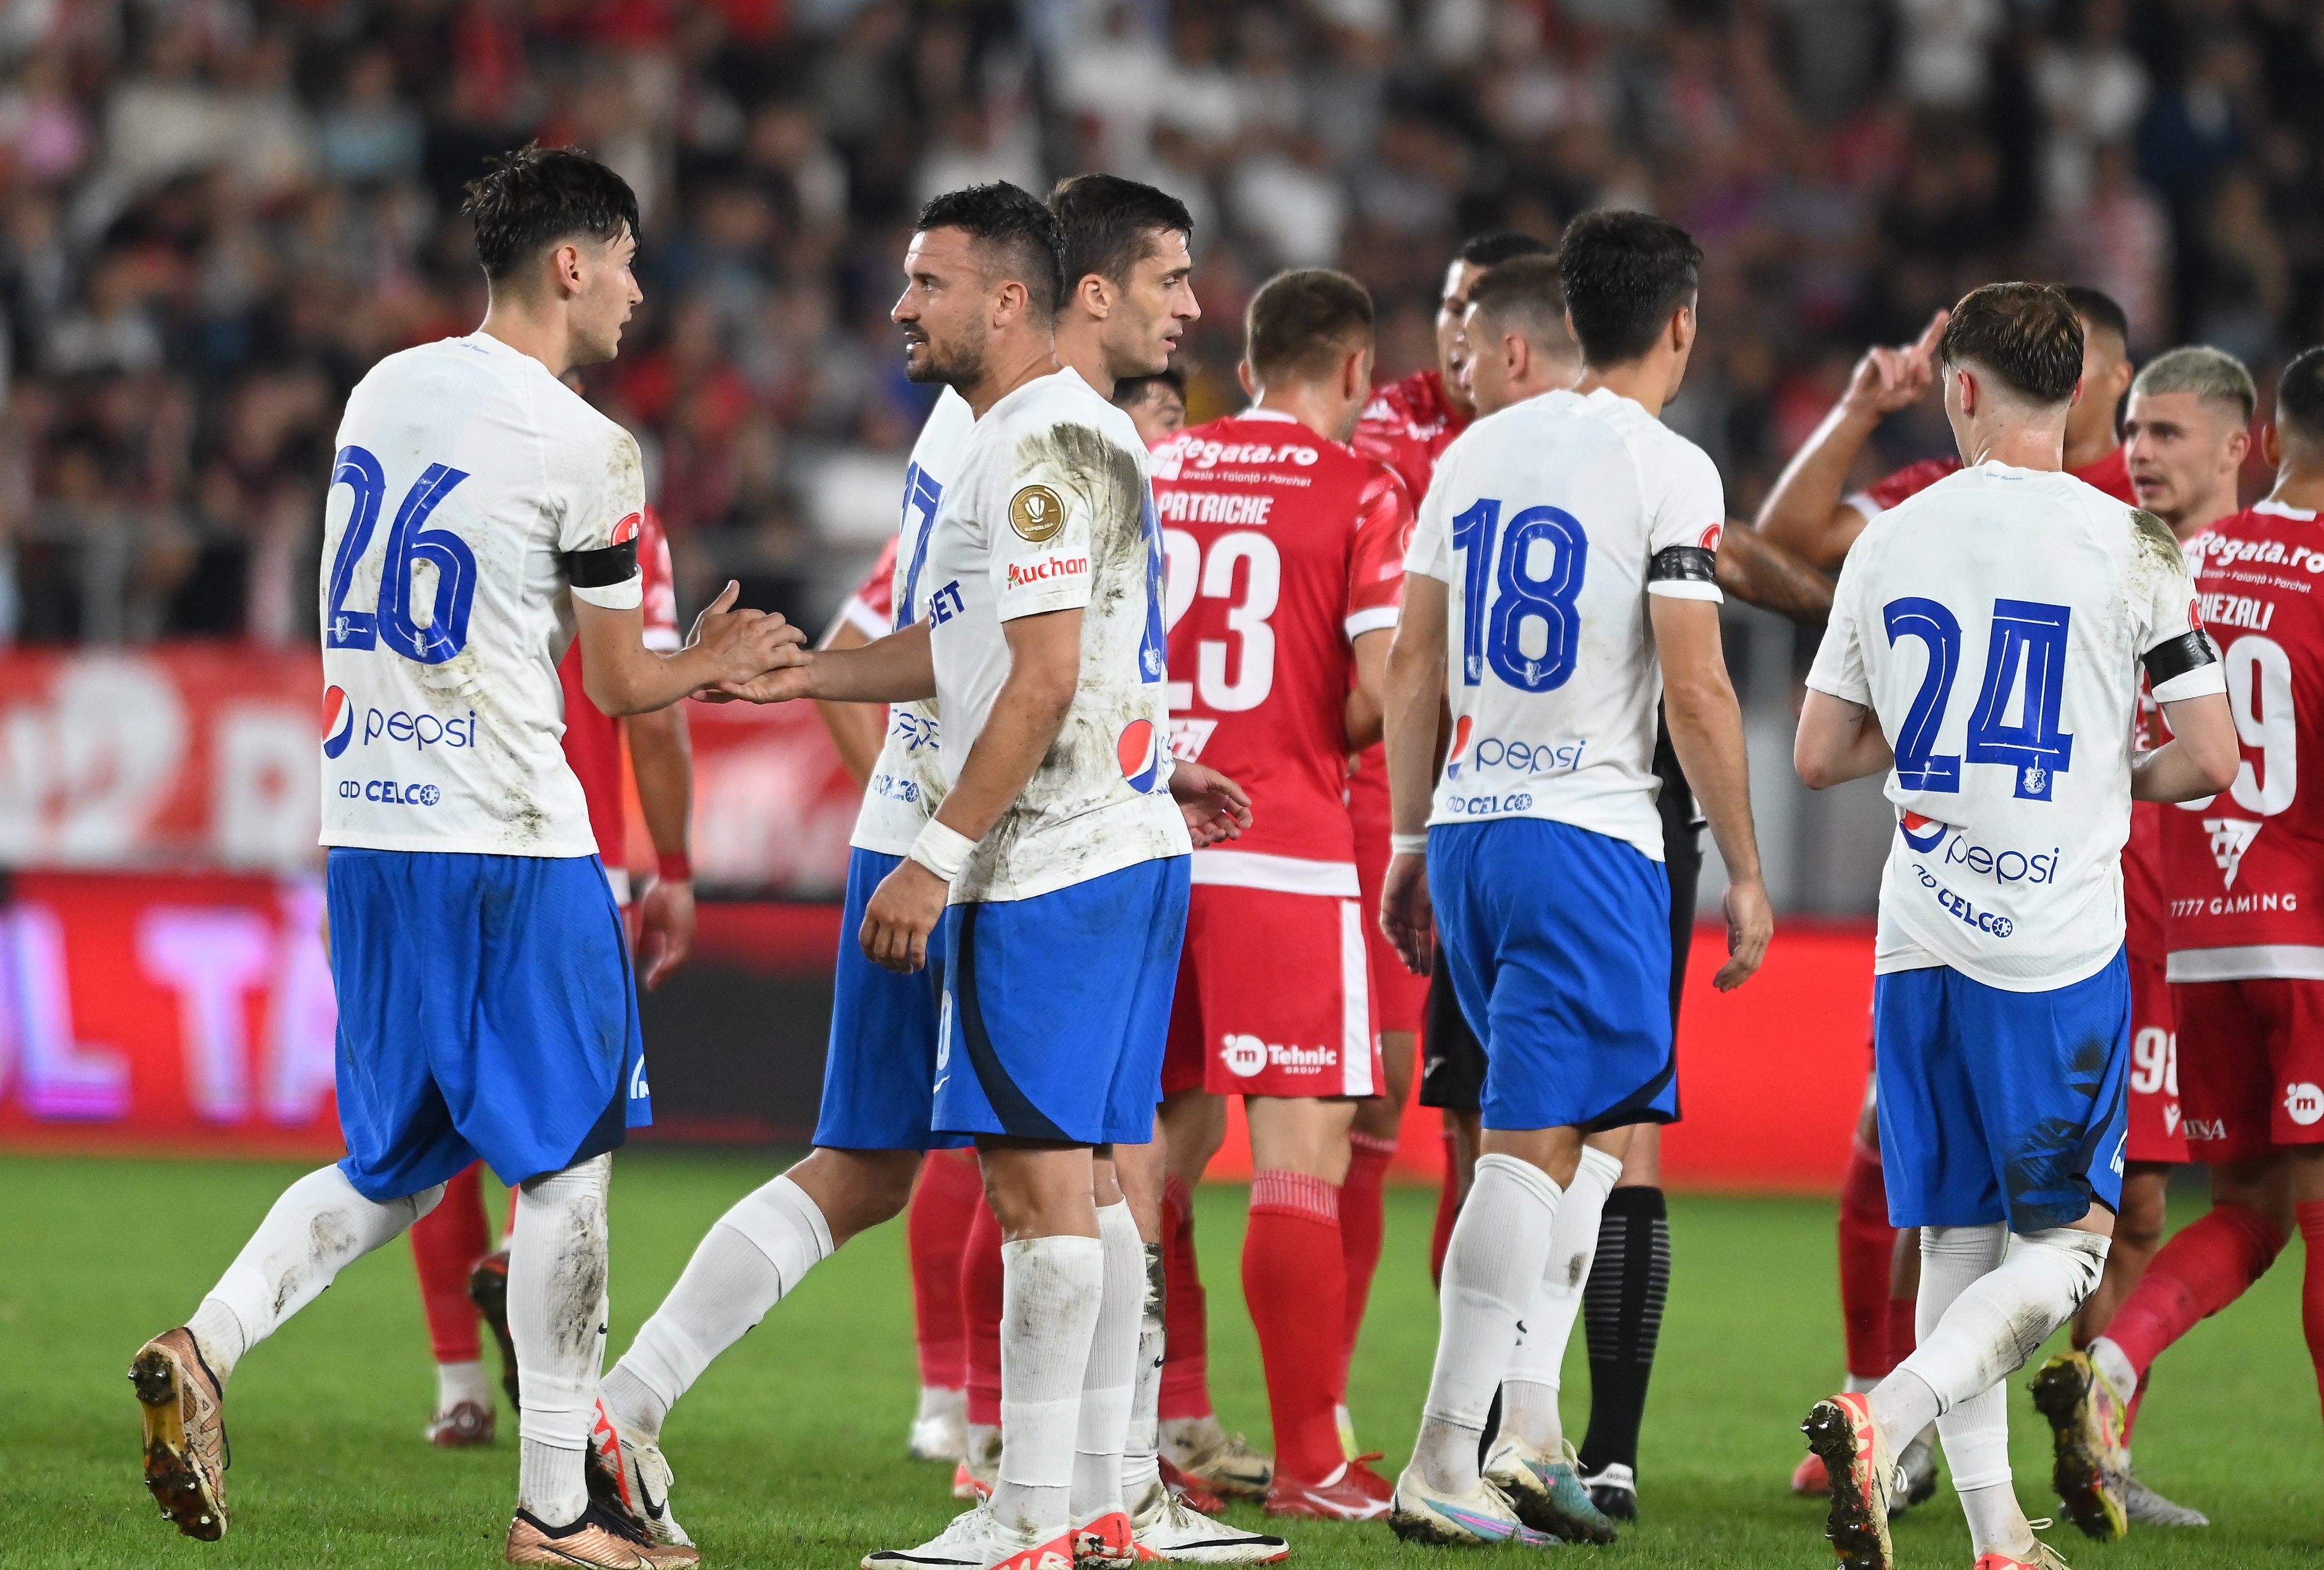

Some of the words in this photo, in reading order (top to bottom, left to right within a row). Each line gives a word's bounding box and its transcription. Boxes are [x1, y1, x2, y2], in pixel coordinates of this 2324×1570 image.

[1159, 491, 1275, 525] PATRICHE
[327, 445, 477, 665] 26
[1008, 556, 1087, 591] Auchan
[1452, 498, 1590, 694] 18
[1163, 529, 1282, 712] 23
[1882, 596, 2074, 802] 24
[364, 707, 476, 751] pepsi
[1476, 737, 1587, 775] pepsi
[1944, 834, 2060, 885] pepsi
[2210, 892, 2297, 915] GAMING
[1268, 1044, 1337, 1066] Tehnic
